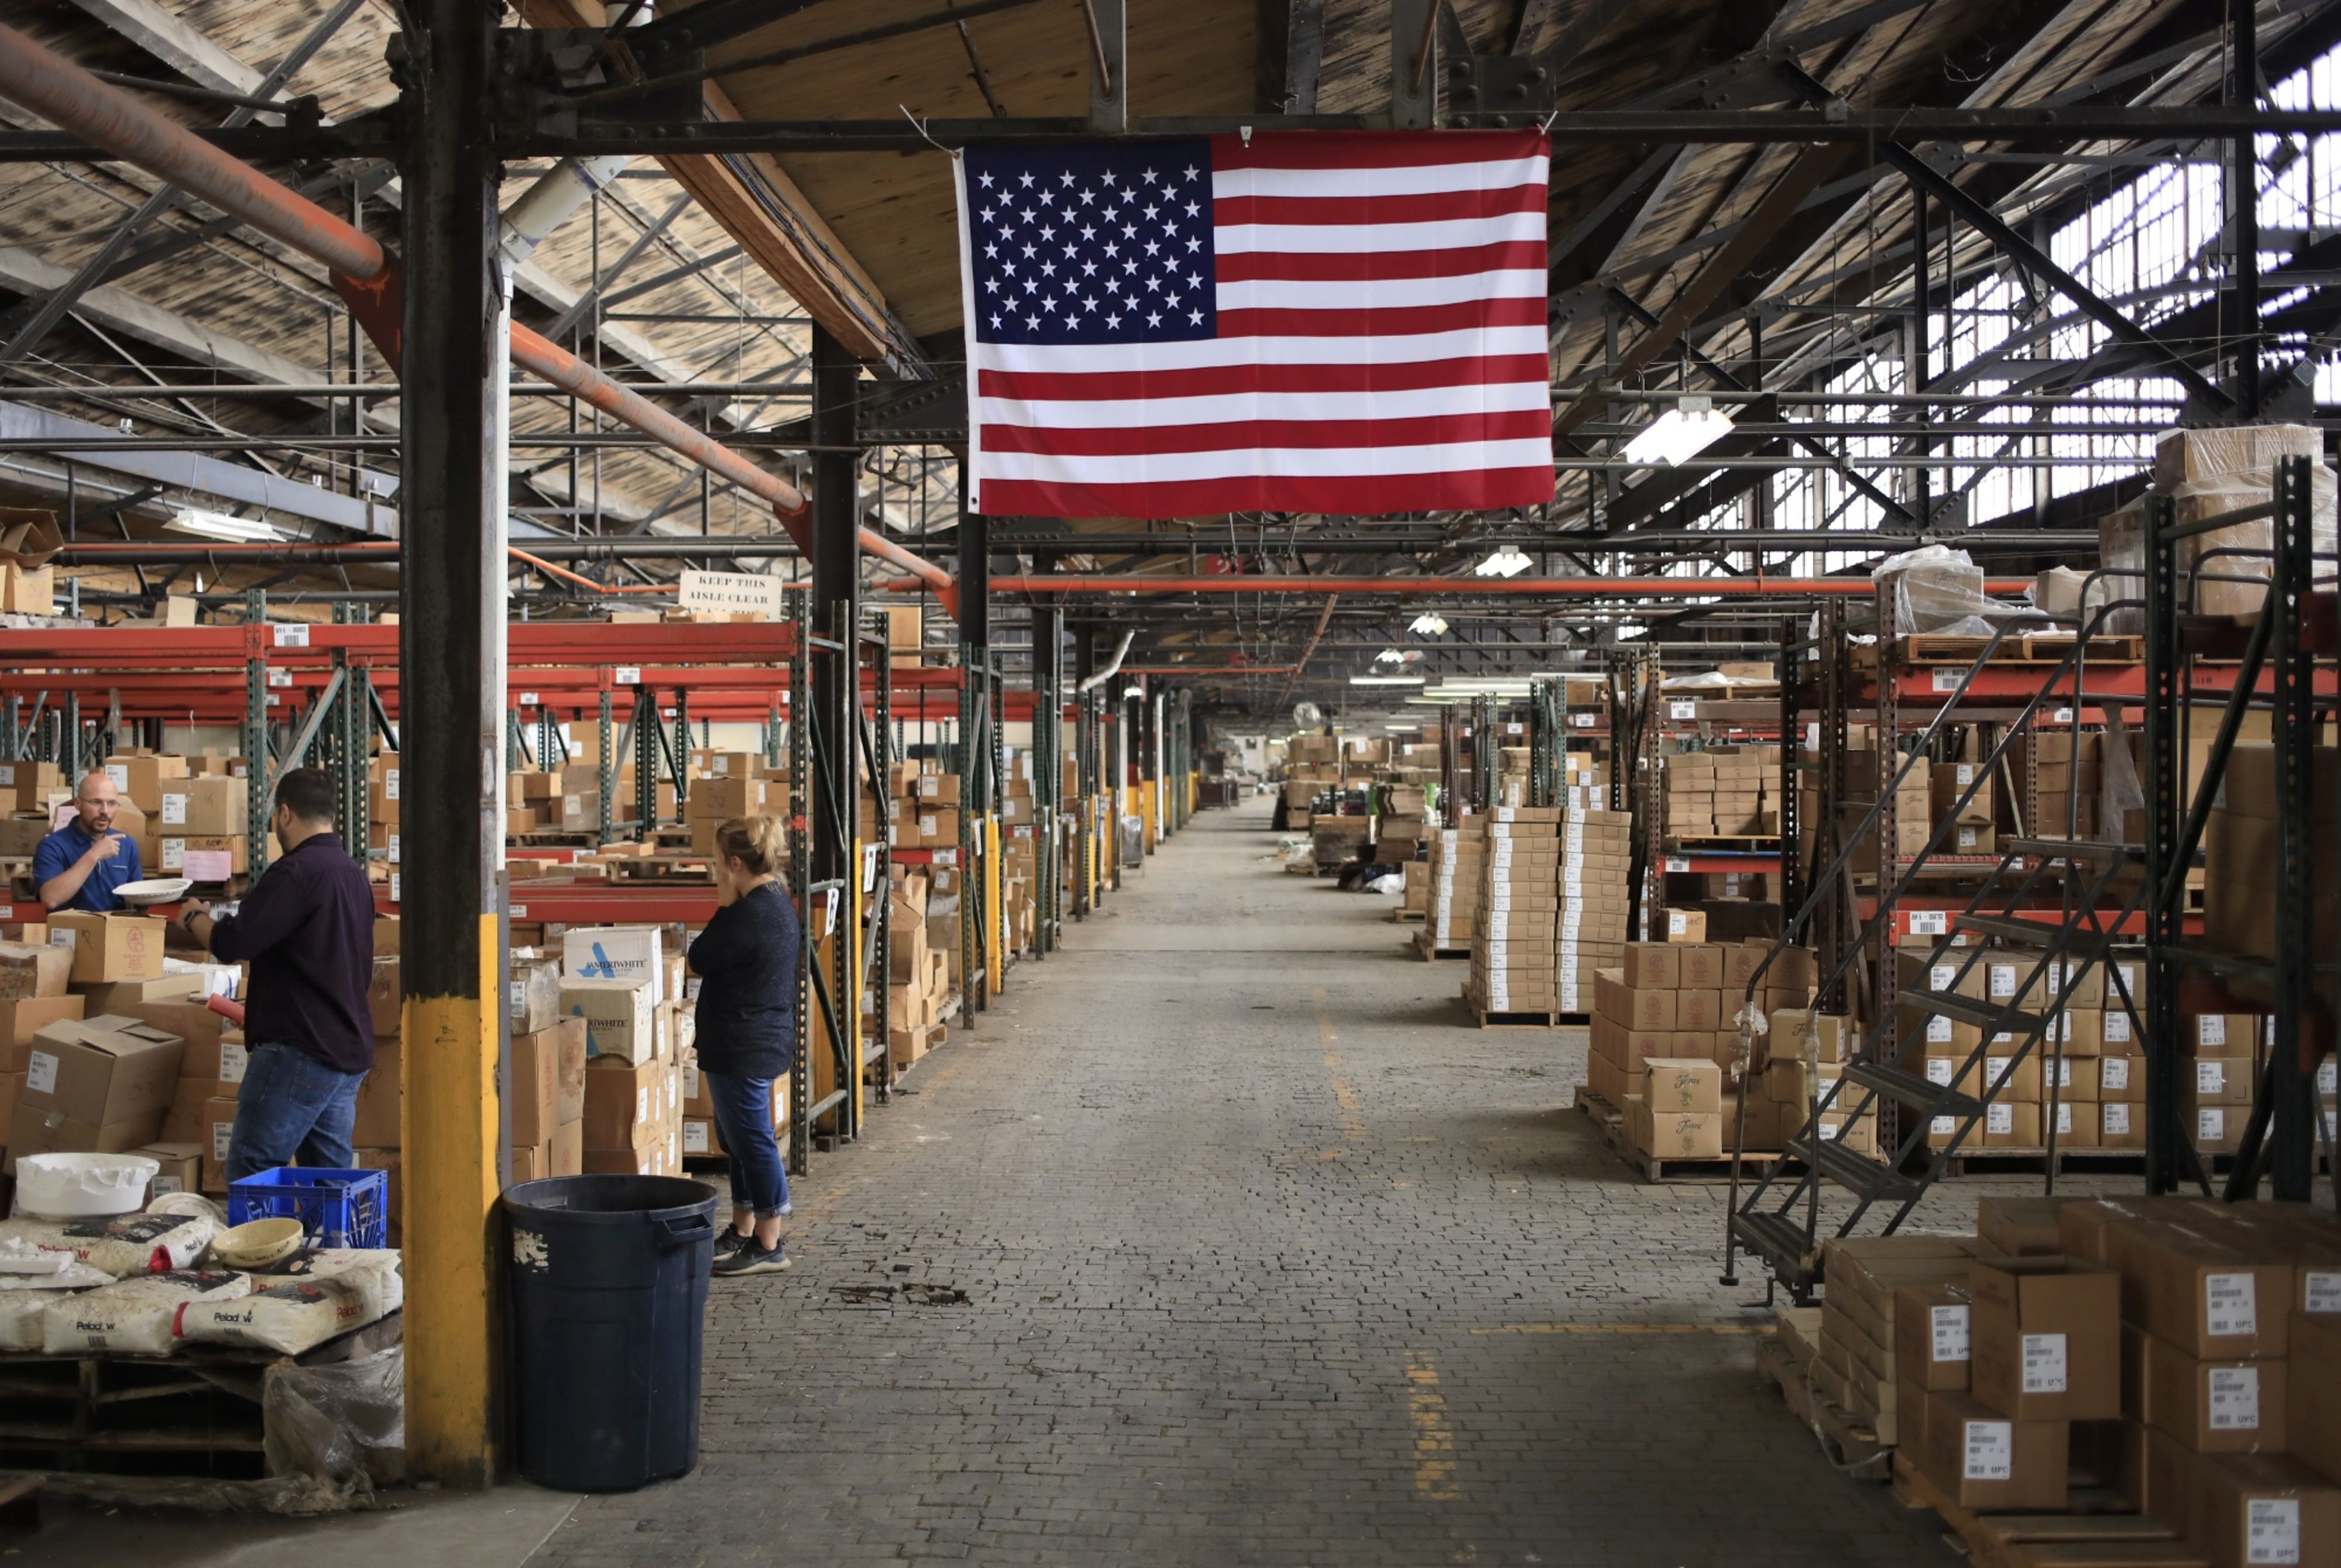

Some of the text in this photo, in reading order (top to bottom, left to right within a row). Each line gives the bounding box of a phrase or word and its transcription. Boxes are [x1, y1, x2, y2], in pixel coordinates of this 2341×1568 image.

[699, 576, 766, 588] KEEP THIS
[689, 592, 768, 604] AISLE CLEAR
[589, 960, 646, 969] AMERIWHITE
[588, 1019, 627, 1027] RIWHITE
[214, 1312, 253, 1323] Peladw
[77, 1321, 115, 1330] Peladw
[2235, 1320, 2254, 1328] UPC
[2237, 1415, 2256, 1423] UPC
[1991, 1466, 2008, 1474] UPC
[2277, 1549, 2295, 1557] UPC
